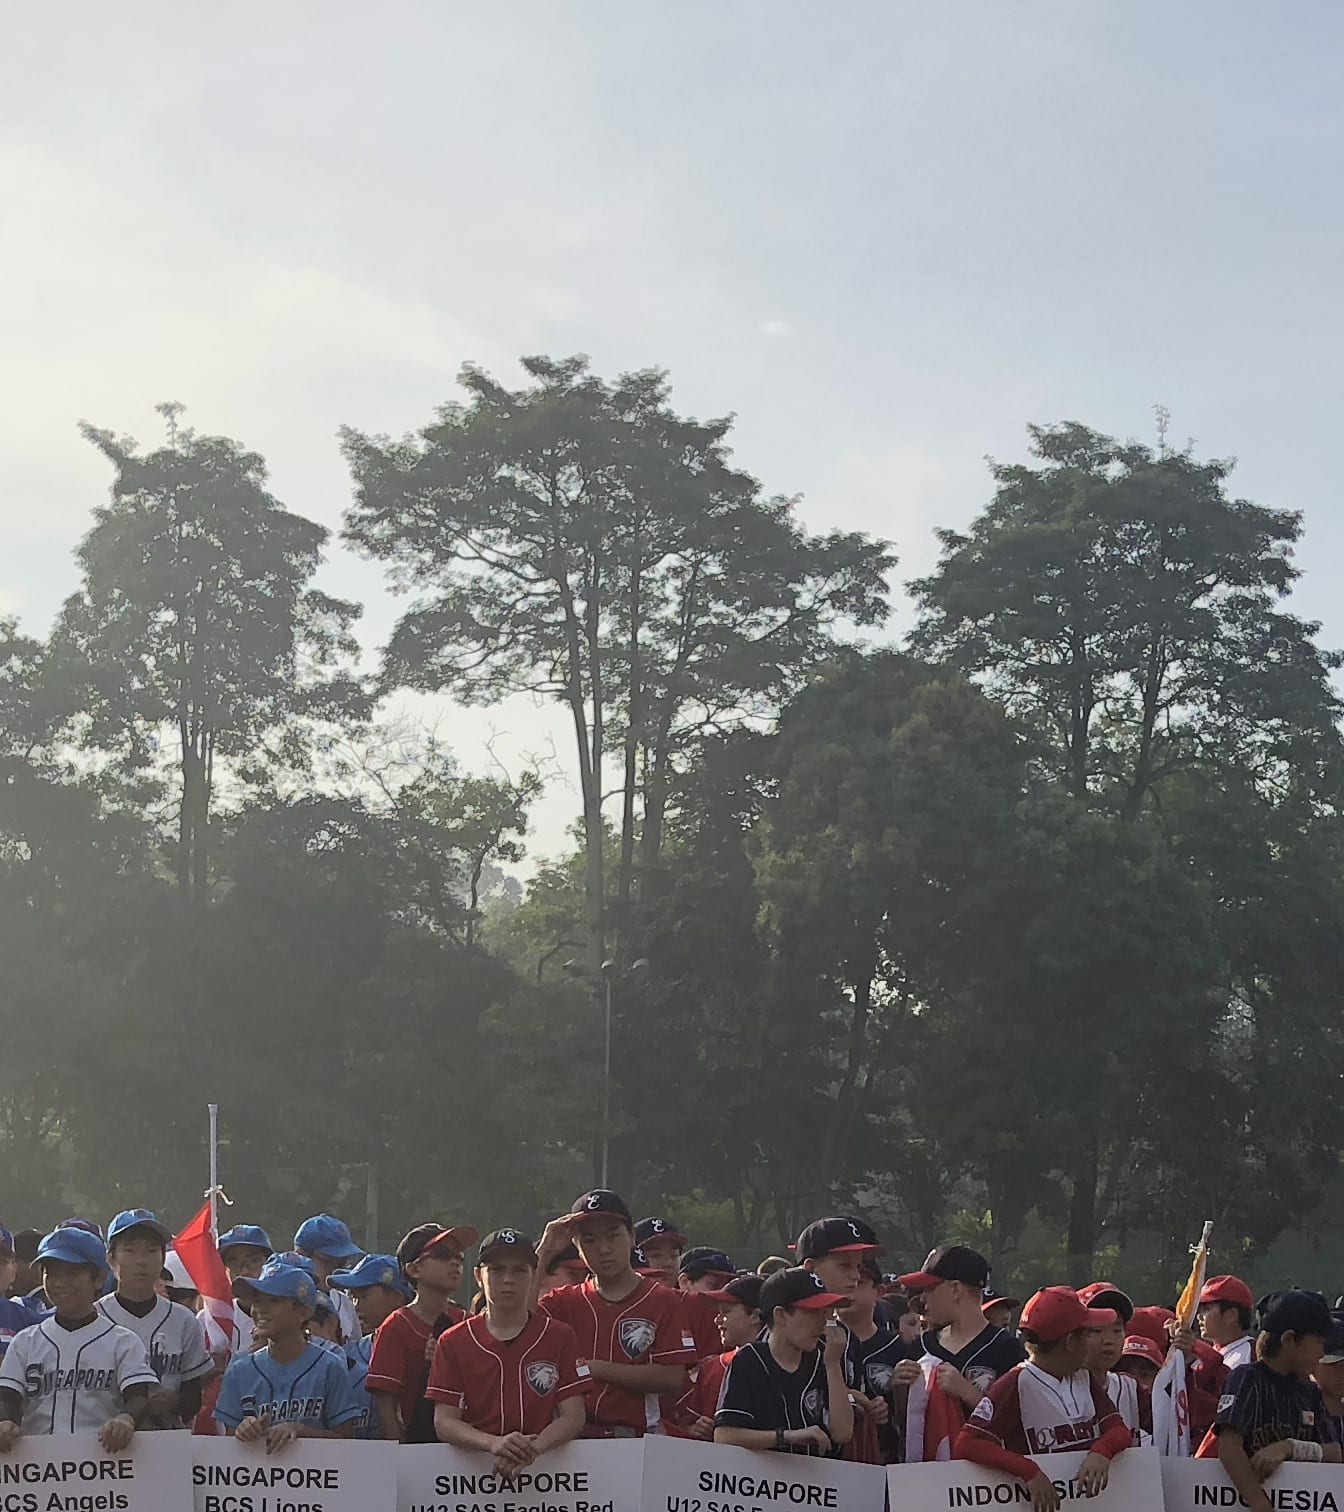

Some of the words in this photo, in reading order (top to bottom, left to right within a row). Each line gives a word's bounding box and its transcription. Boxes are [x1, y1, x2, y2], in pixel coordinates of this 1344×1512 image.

[587, 1194, 600, 1209] E
[192, 1465, 339, 1489] SINGAPORE
[434, 1472, 589, 1496] SINGAPORE
[698, 1470, 838, 1508] SINGAPORE
[948, 1479, 1094, 1508] INDONSIA
